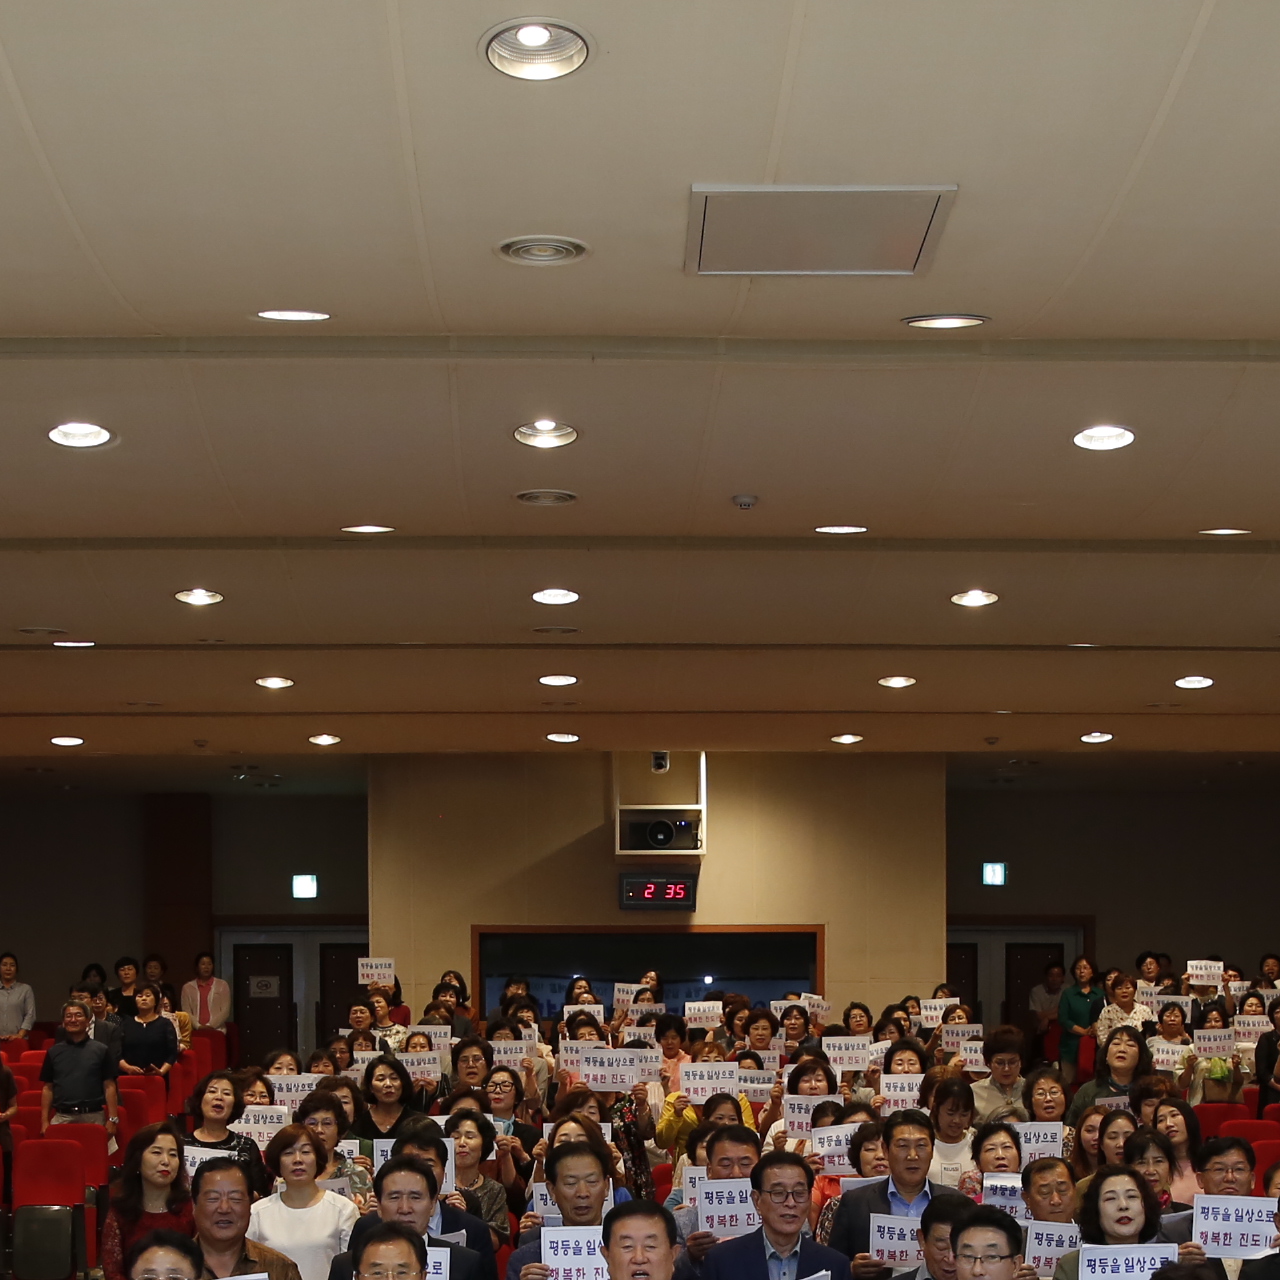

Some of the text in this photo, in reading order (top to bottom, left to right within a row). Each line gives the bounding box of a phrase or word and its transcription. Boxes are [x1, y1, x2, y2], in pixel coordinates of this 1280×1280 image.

[644, 884, 685, 898] 2 35
[584, 1056, 635, 1067] 평등을 일상으로
[584, 1073, 634, 1084] 행복한 진도!!
[683, 1069, 735, 1080] 평등을 일상으로
[885, 1082, 906, 1092] 평등을
[788, 1103, 811, 1115] 평등을
[252, 1114, 284, 1125] 일상으로
[817, 1135, 842, 1149] 평등을
[1023, 1132, 1058, 1144] 일상으로
[989, 1184, 1017, 1197] 평등을
[704, 1190, 735, 1206] 평등을
[1200, 1205, 1275, 1223] 평등을 일상으로
[705, 1214, 739, 1229] 행복한
[876, 1225, 908, 1242] 평등을
[1034, 1232, 1065, 1248] 평등을
[1199, 1231, 1233, 1247] 행복한
[549, 1240, 583, 1257] 평등을
[875, 1249, 909, 1261] 행복한
[1086, 1257, 1121, 1274] 평등을
